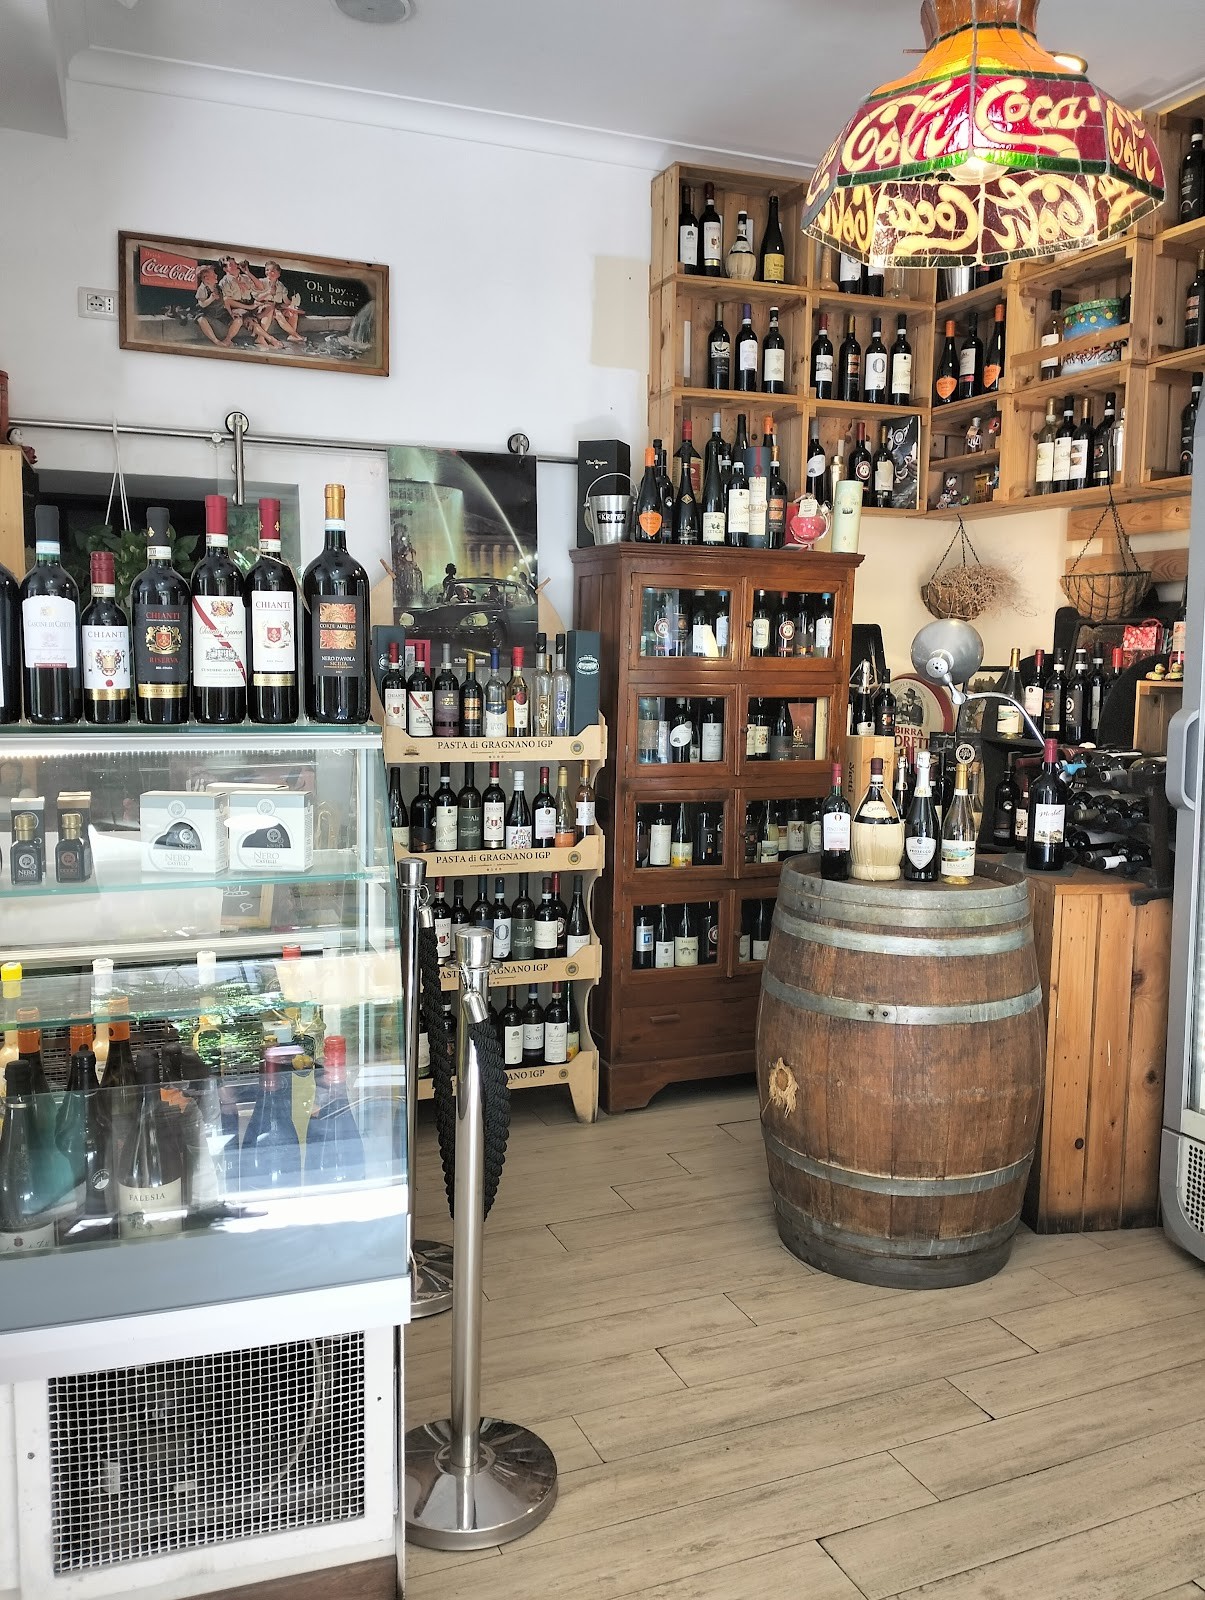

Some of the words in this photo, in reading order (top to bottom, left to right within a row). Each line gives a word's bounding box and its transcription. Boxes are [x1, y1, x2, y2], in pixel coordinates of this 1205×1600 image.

[310, 293, 325, 304] it's
[255, 601, 291, 609] CHIANTI
[145, 611, 180, 620] CHIANTI
[895, 726, 923, 737] BIRRA
[437, 741, 468, 750] PASTA
[470, 741, 478, 749] di
[481, 740, 536, 749] GRAGNANO
[538, 740, 553, 748] IGP
[707, 834, 713, 842] R
[165, 853, 190, 861] NERO
[254, 851, 280, 860] NERO
[436, 856, 466, 864] PASTA
[468, 854, 478, 862] di
[480, 852, 532, 862] GRAGNANO
[535, 851, 551, 860] IGP
[533, 963, 549, 972] IGP
[530, 1069, 545, 1078] IGP
[129, 1192, 166, 1202] FALESIA
